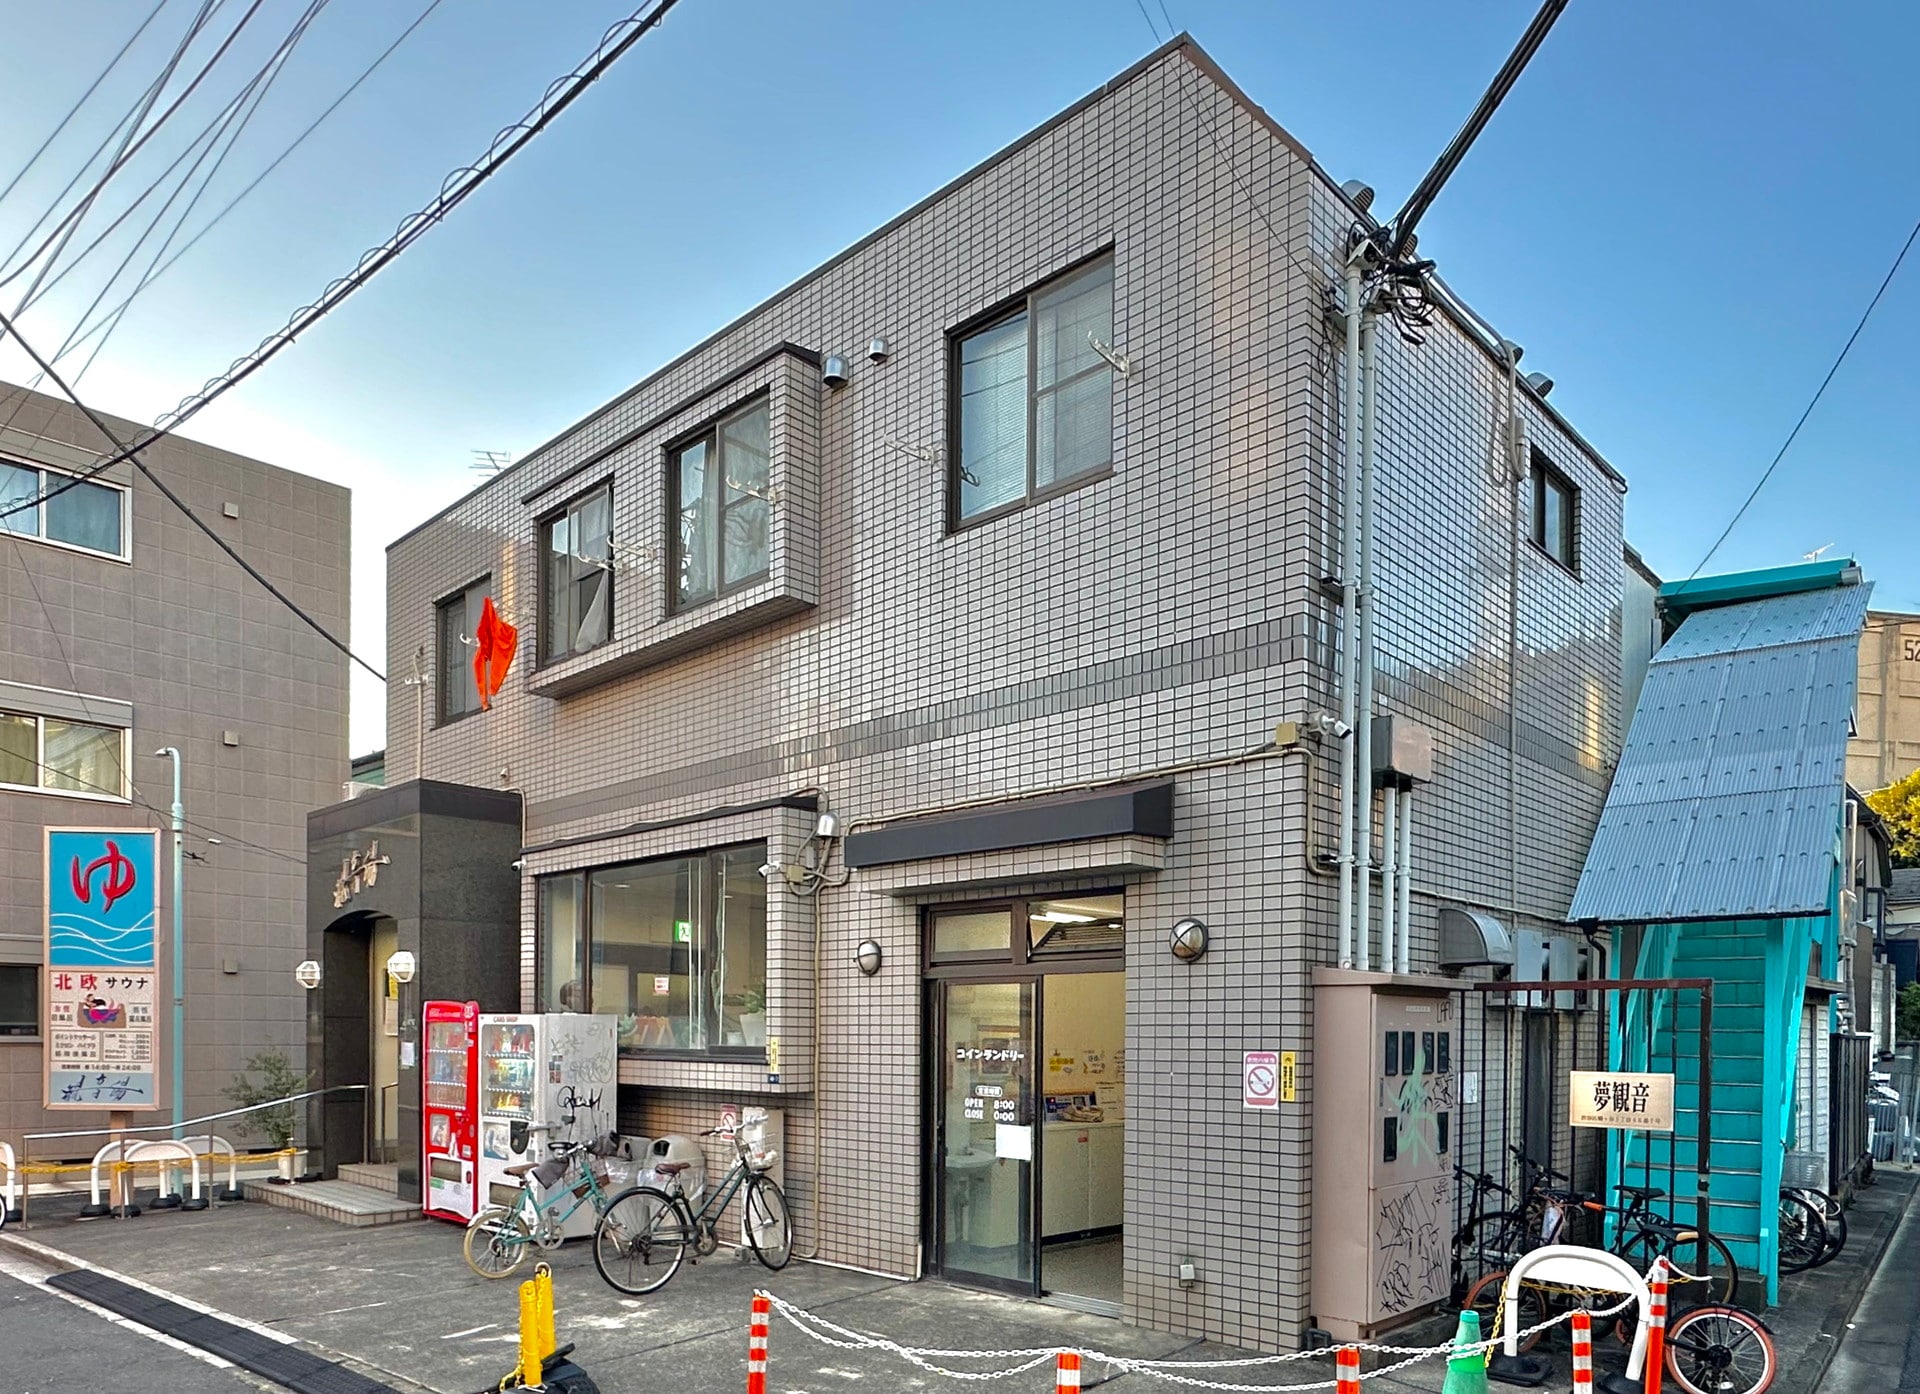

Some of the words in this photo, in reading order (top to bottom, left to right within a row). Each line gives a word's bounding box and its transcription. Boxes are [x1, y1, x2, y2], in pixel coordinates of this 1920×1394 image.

[71, 840, 136, 914] ゆ
[956, 1049, 1025, 1061] コインランドリー
[964, 1097, 984, 1108] OPEN
[993, 1099, 1015, 1111] 8:00
[1593, 1081, 1650, 1113] 夢観音
[964, 1108, 984, 1120] CLOSE
[993, 1110, 1015, 1122] 0:00
